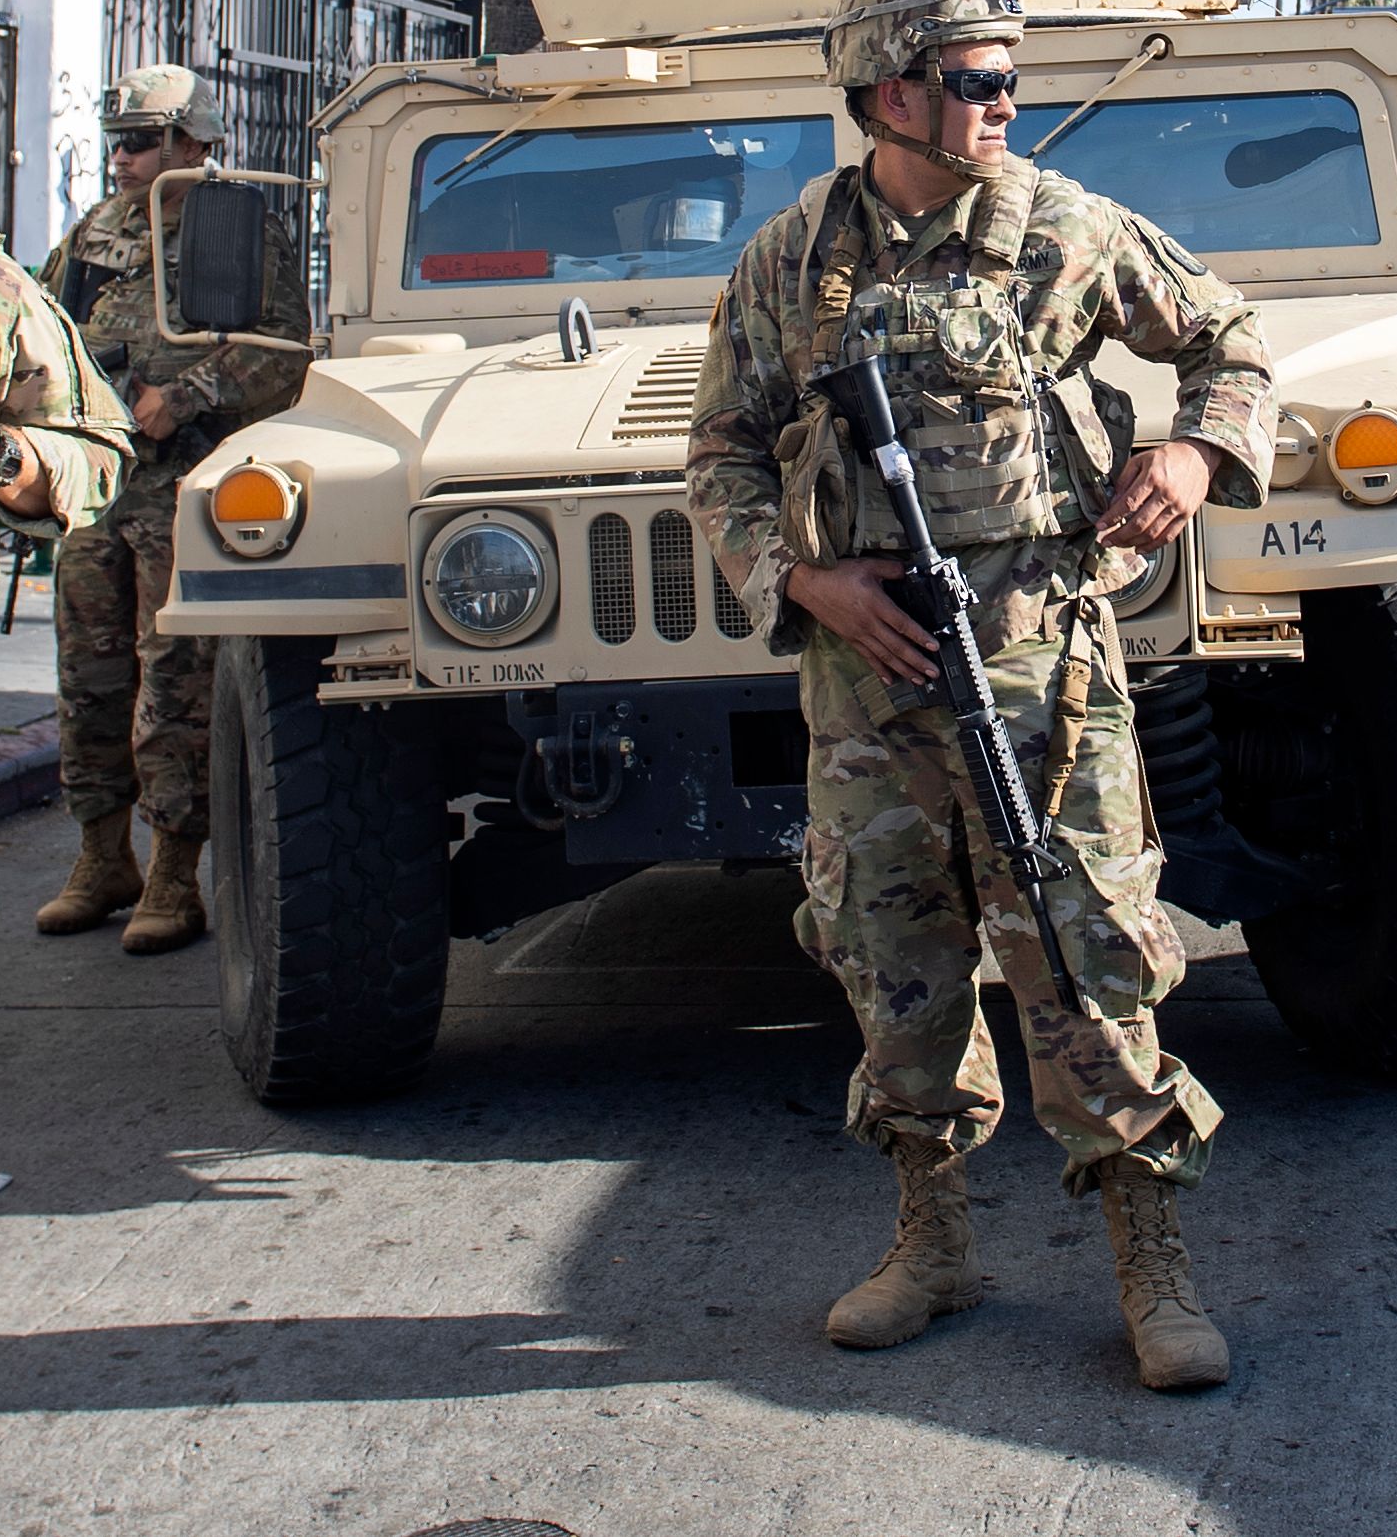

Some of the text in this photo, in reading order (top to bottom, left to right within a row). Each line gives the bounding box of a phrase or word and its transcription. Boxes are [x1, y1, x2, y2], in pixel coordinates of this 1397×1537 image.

[1261, 519, 1326, 557] A14
[443, 663, 544, 684] TIE DOWN
